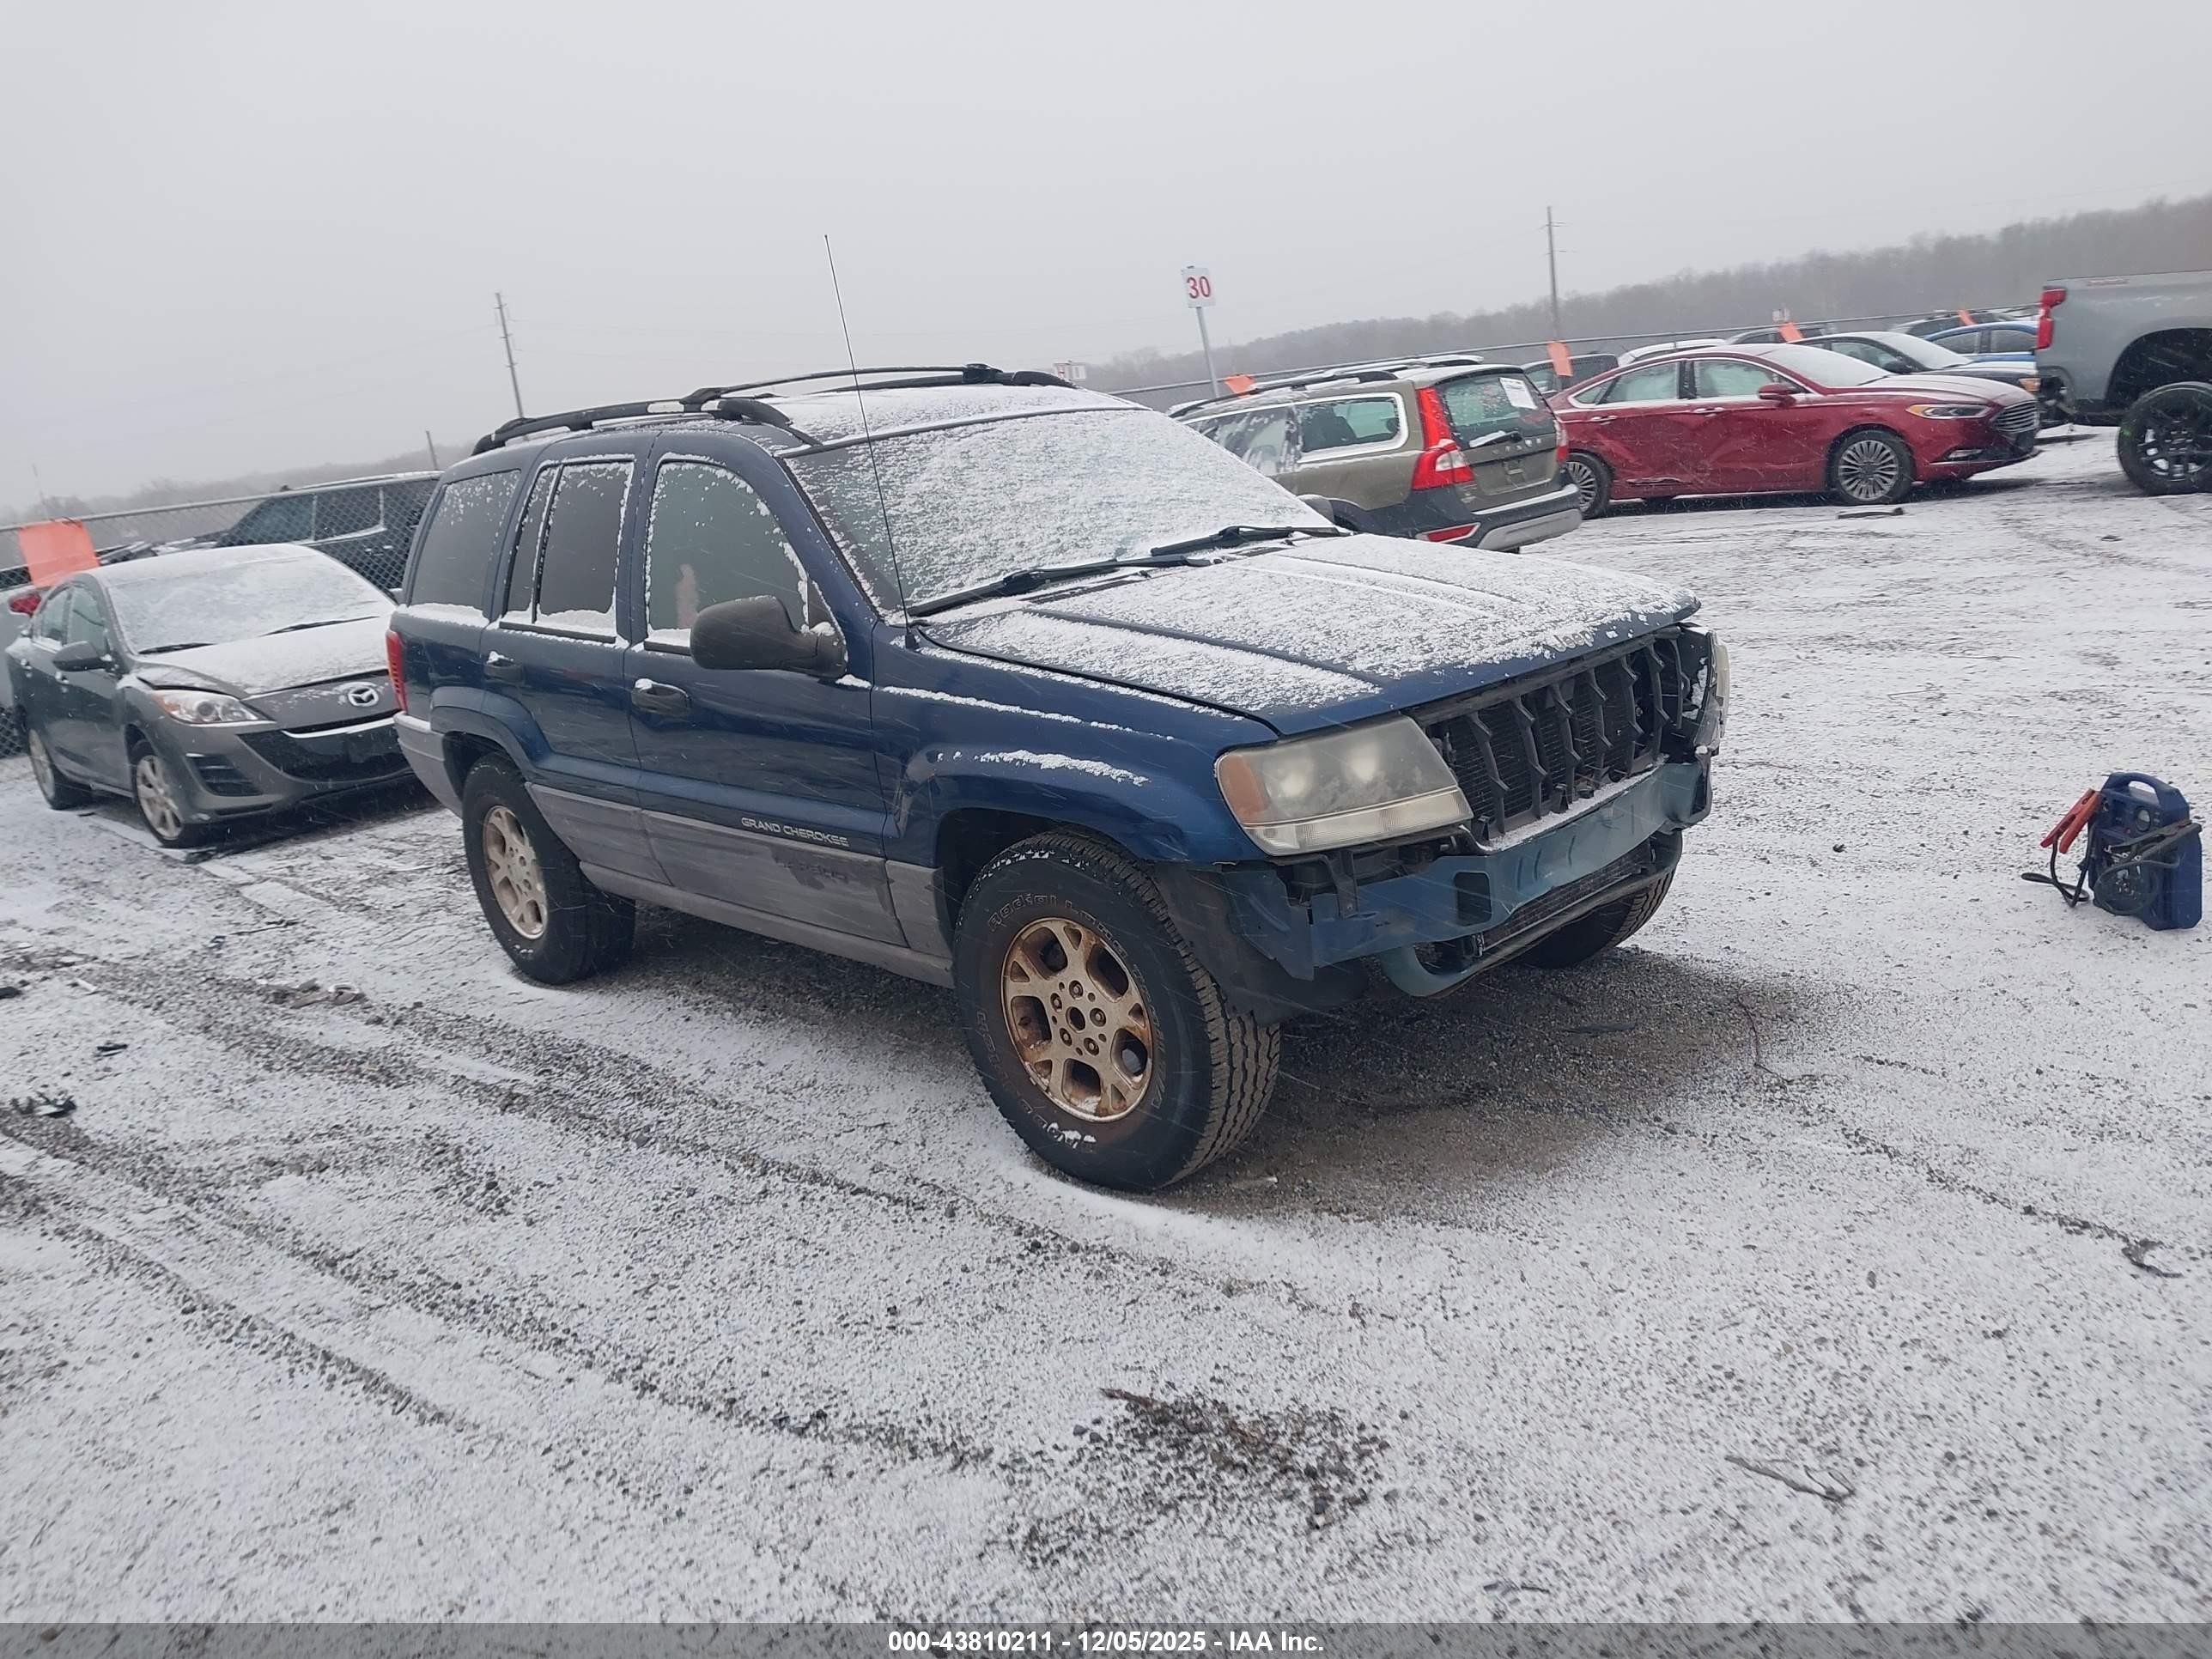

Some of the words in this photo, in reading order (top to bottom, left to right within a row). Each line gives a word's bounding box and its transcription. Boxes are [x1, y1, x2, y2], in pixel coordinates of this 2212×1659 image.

[1186, 275, 1212, 299] 30
[1550, 629, 1595, 653] Jeep
[741, 817, 781, 833] GRAND
[782, 825, 849, 848] CHEROKEE
